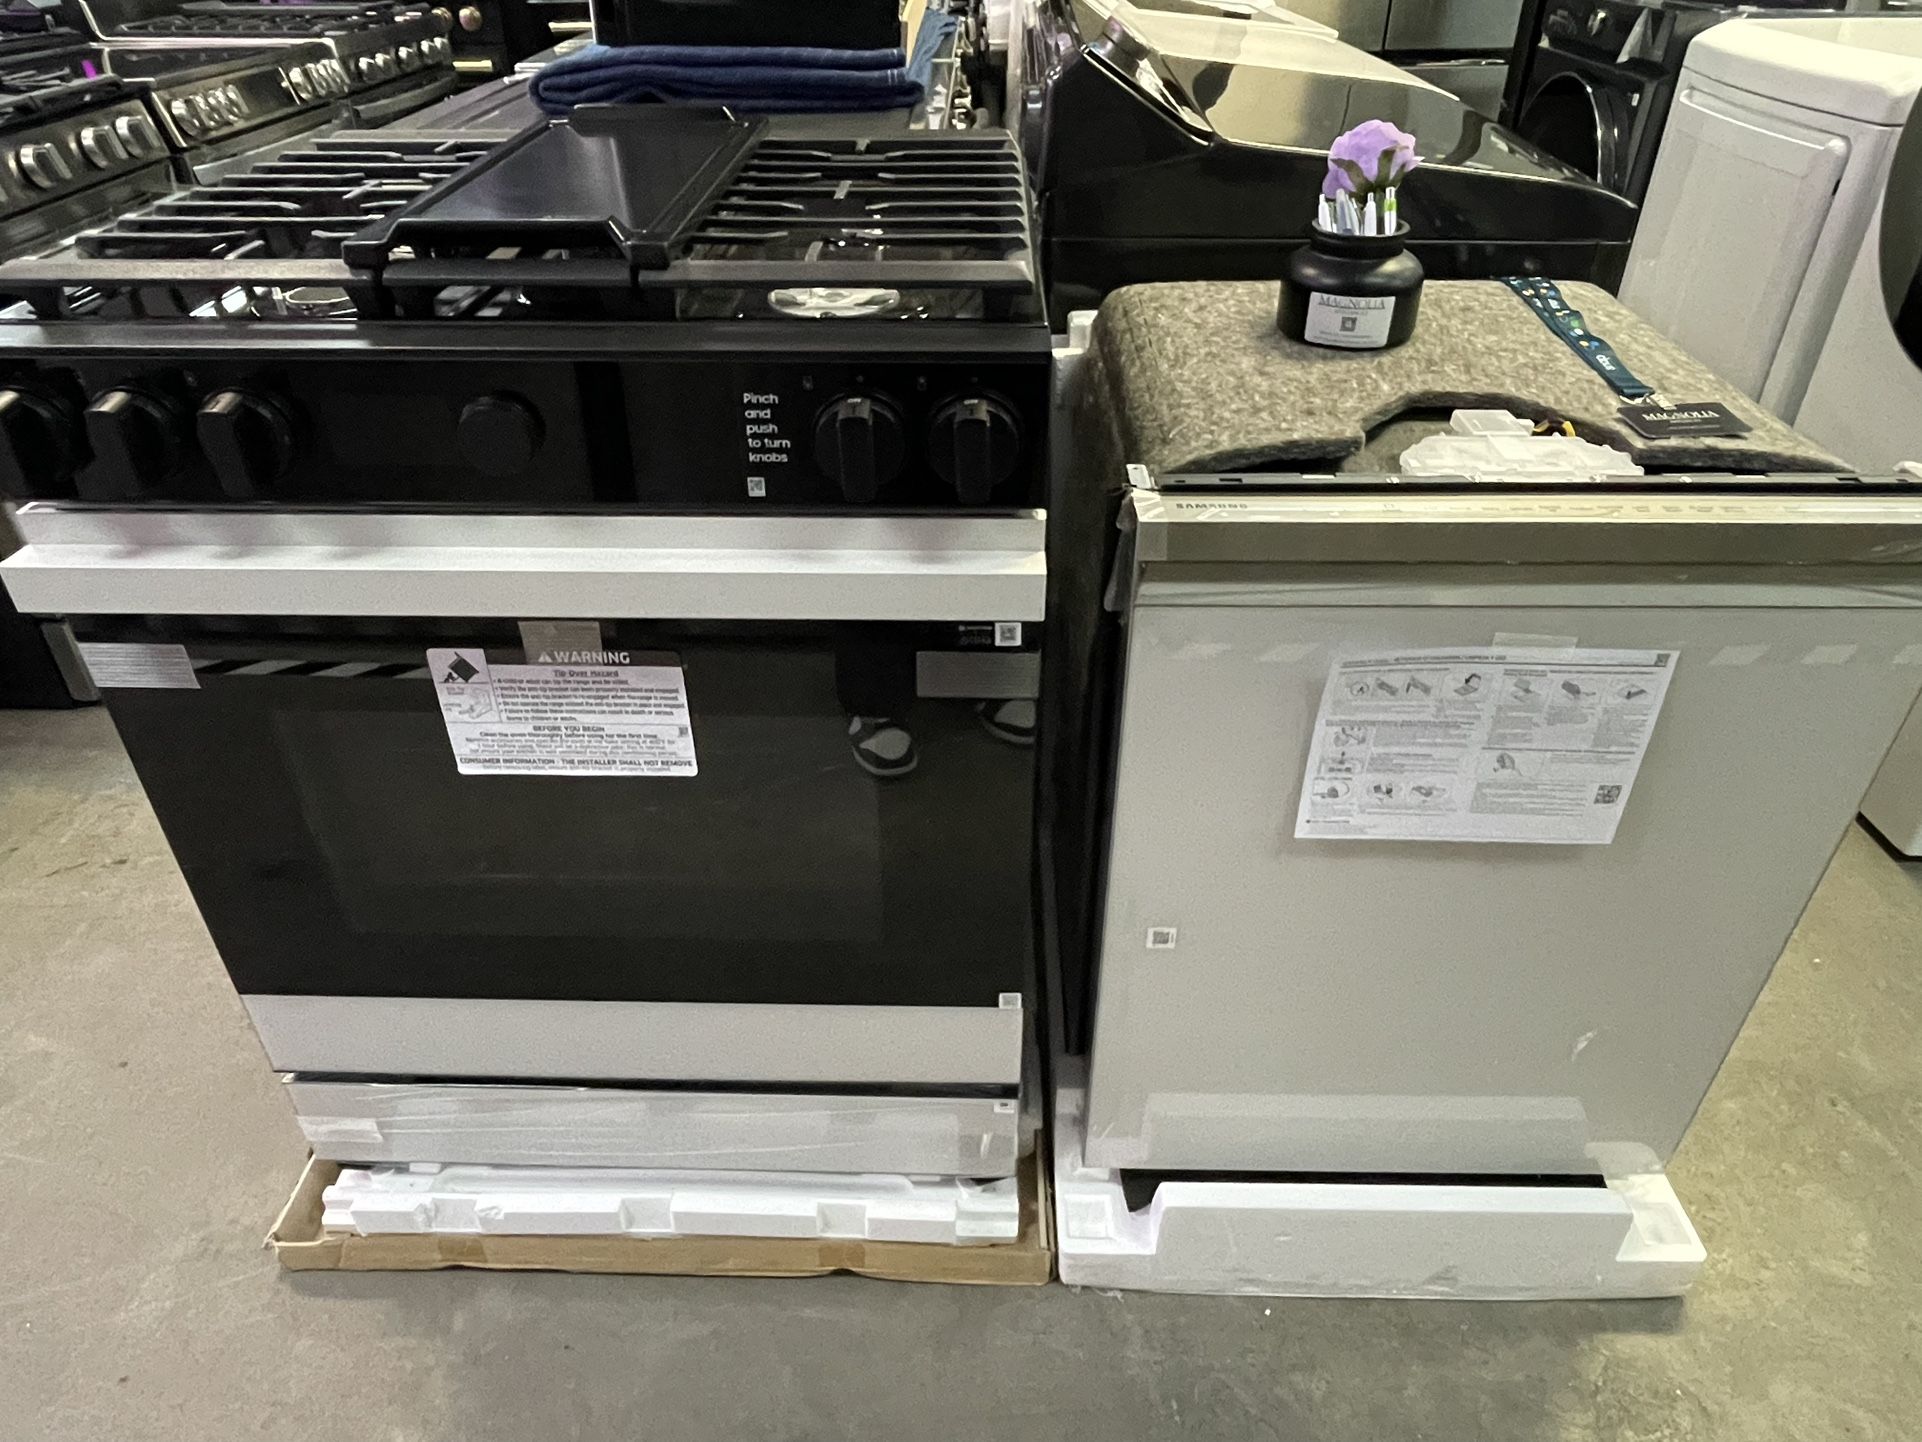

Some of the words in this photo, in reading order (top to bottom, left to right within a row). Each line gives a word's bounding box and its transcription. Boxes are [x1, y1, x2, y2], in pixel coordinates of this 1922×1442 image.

[1318, 294, 1385, 309] MAGNOLIA
[743, 392, 779, 404] Pinch
[744, 408, 771, 419] and
[1641, 410, 1720, 420] MAGNOLIA
[746, 423, 778, 436] push
[747, 438, 761, 448] to
[764, 438, 791, 448] turn
[748, 452, 788, 462] knobs
[554, 651, 630, 664] WARNING
[568, 670, 588, 678] Over
[590, 670, 619, 678] Hazard
